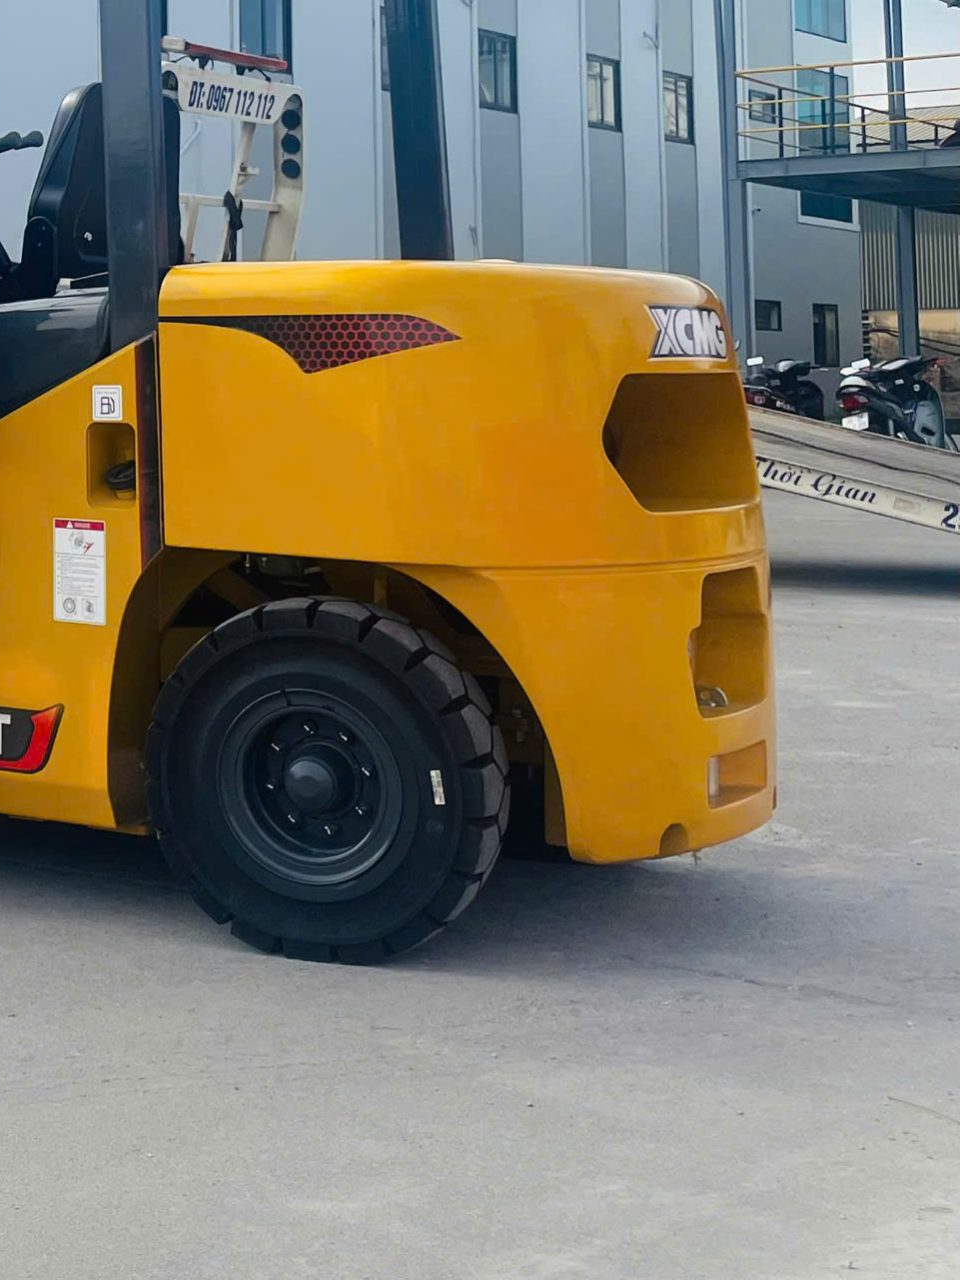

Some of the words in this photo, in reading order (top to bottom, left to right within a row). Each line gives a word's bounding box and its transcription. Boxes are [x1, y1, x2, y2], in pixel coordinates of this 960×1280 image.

[206, 84, 234, 113] 0967
[235, 89, 255, 117] 112
[256, 93, 276, 120] 112
[650, 308, 727, 357] XCMG
[811, 474, 878, 503] Gian
[941, 502, 960, 530] 2
